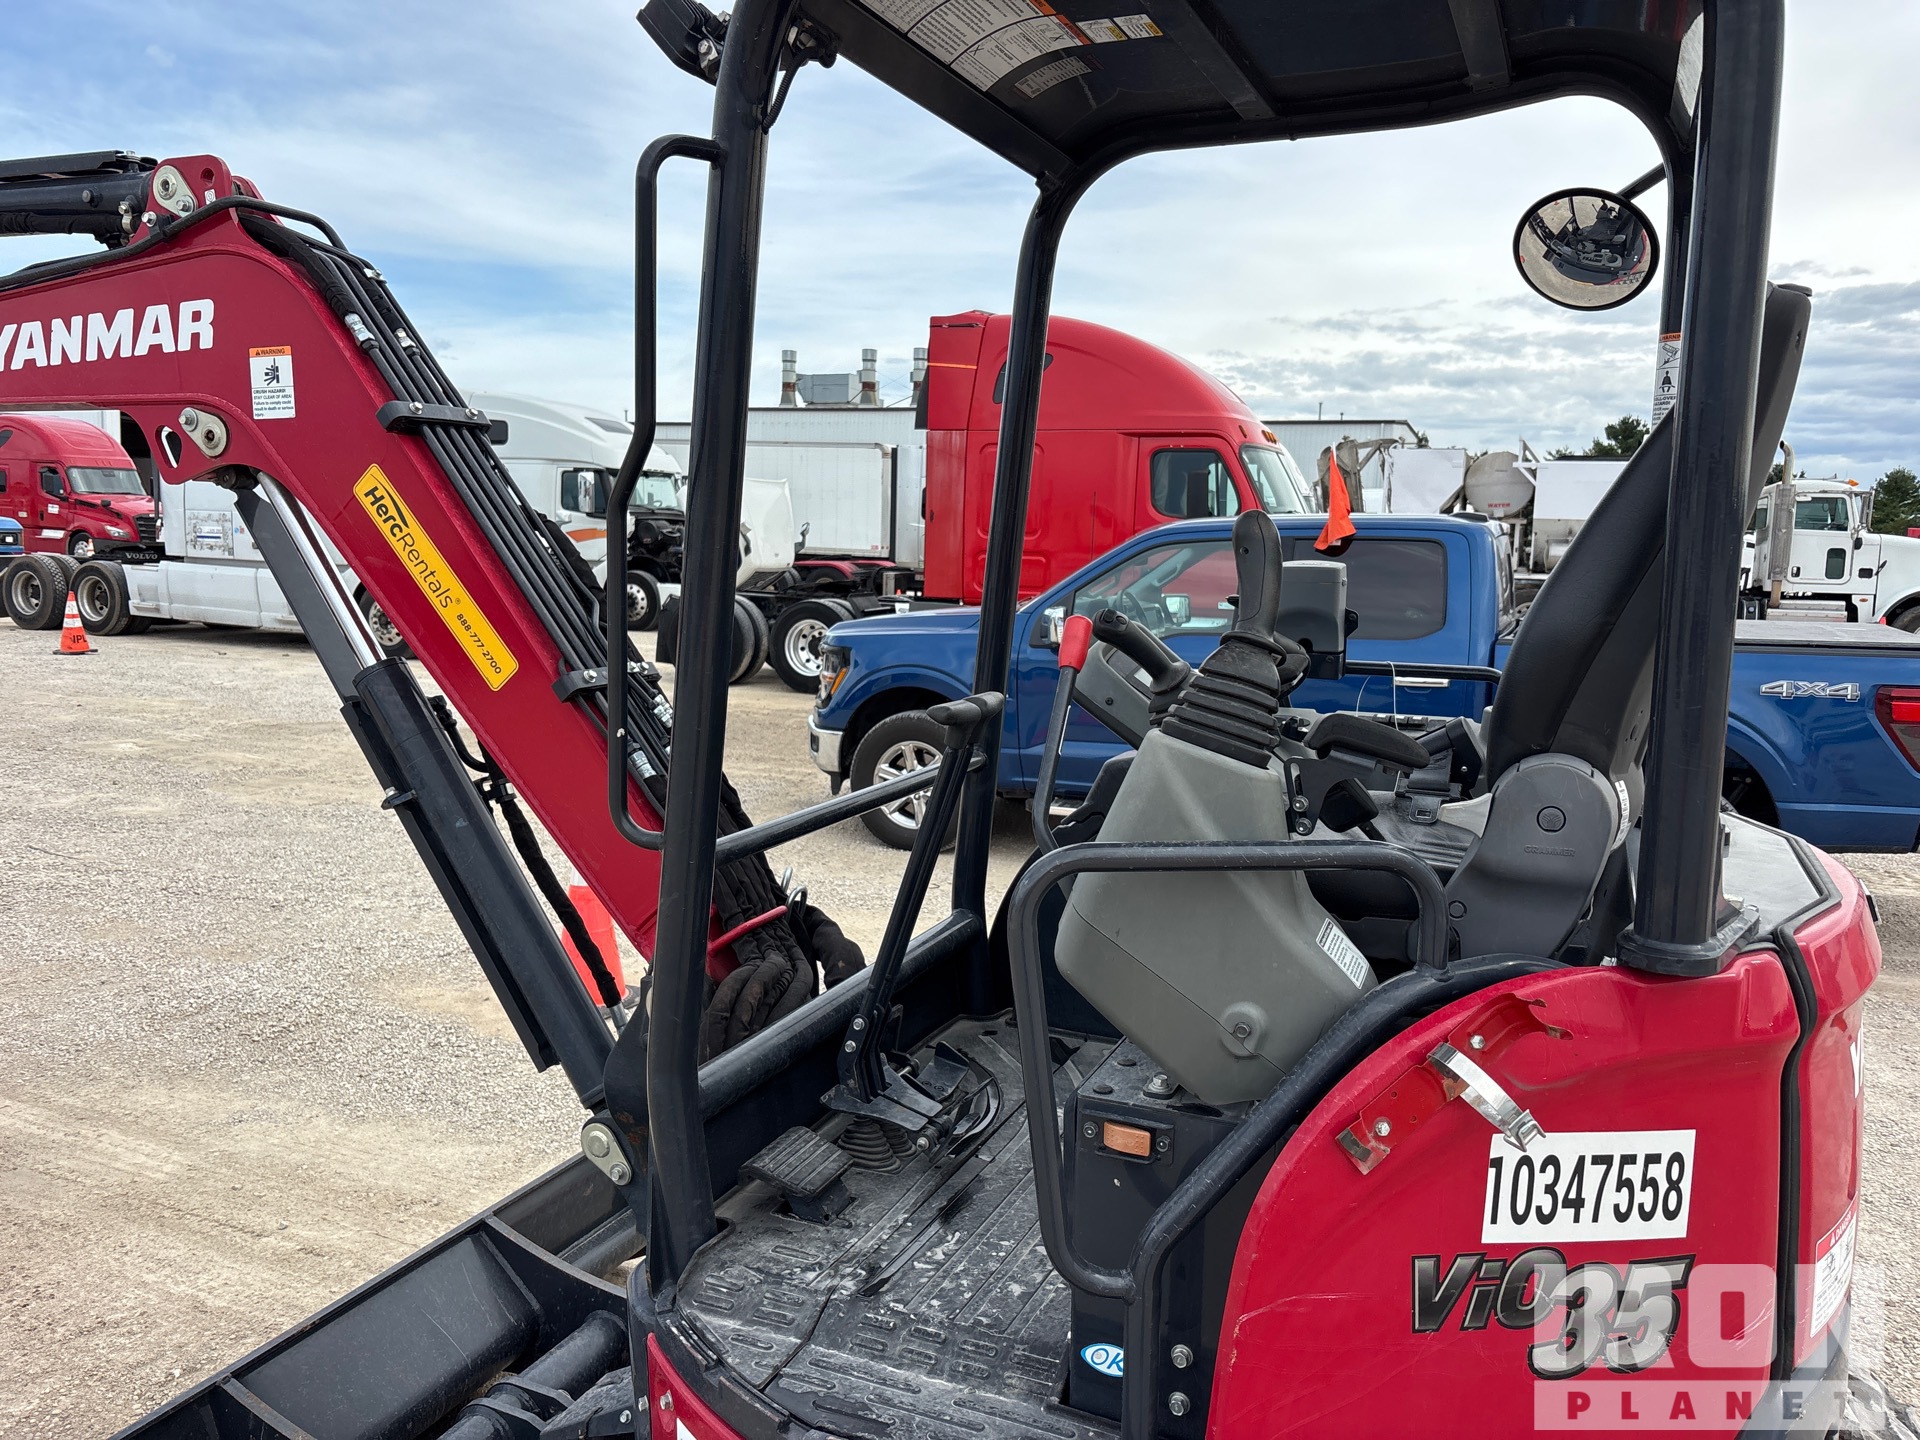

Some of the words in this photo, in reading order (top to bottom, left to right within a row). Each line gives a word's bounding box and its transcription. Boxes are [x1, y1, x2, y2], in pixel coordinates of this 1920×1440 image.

[125, 552, 158, 560] VOLVO
[456, 613, 502, 675] 888-777-2700
[1489, 1151, 1686, 1226] 10347558
